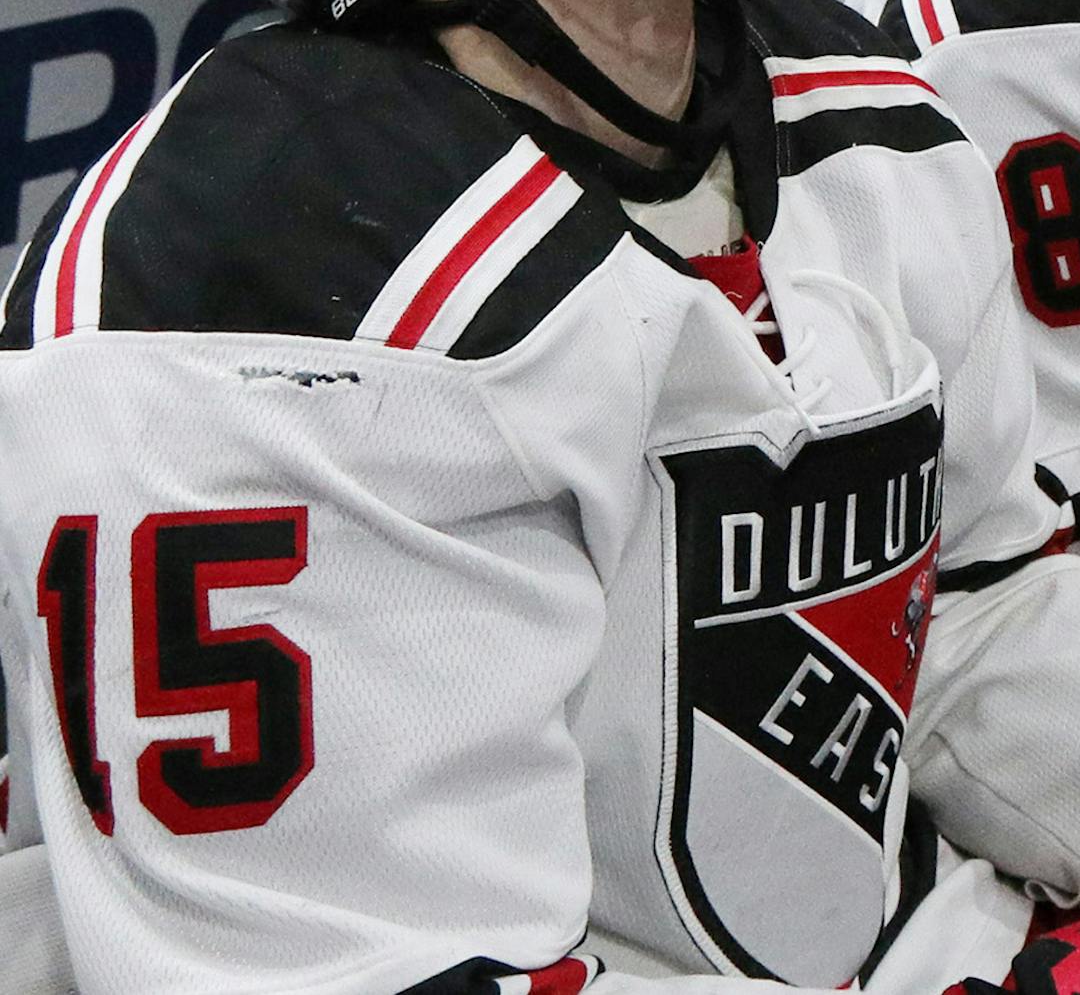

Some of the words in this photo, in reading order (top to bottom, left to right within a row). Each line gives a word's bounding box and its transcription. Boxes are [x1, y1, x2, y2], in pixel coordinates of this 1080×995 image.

[720, 448, 944, 605] DULUTH
[37, 505, 315, 837] 15
[758, 652, 900, 813] EAS
